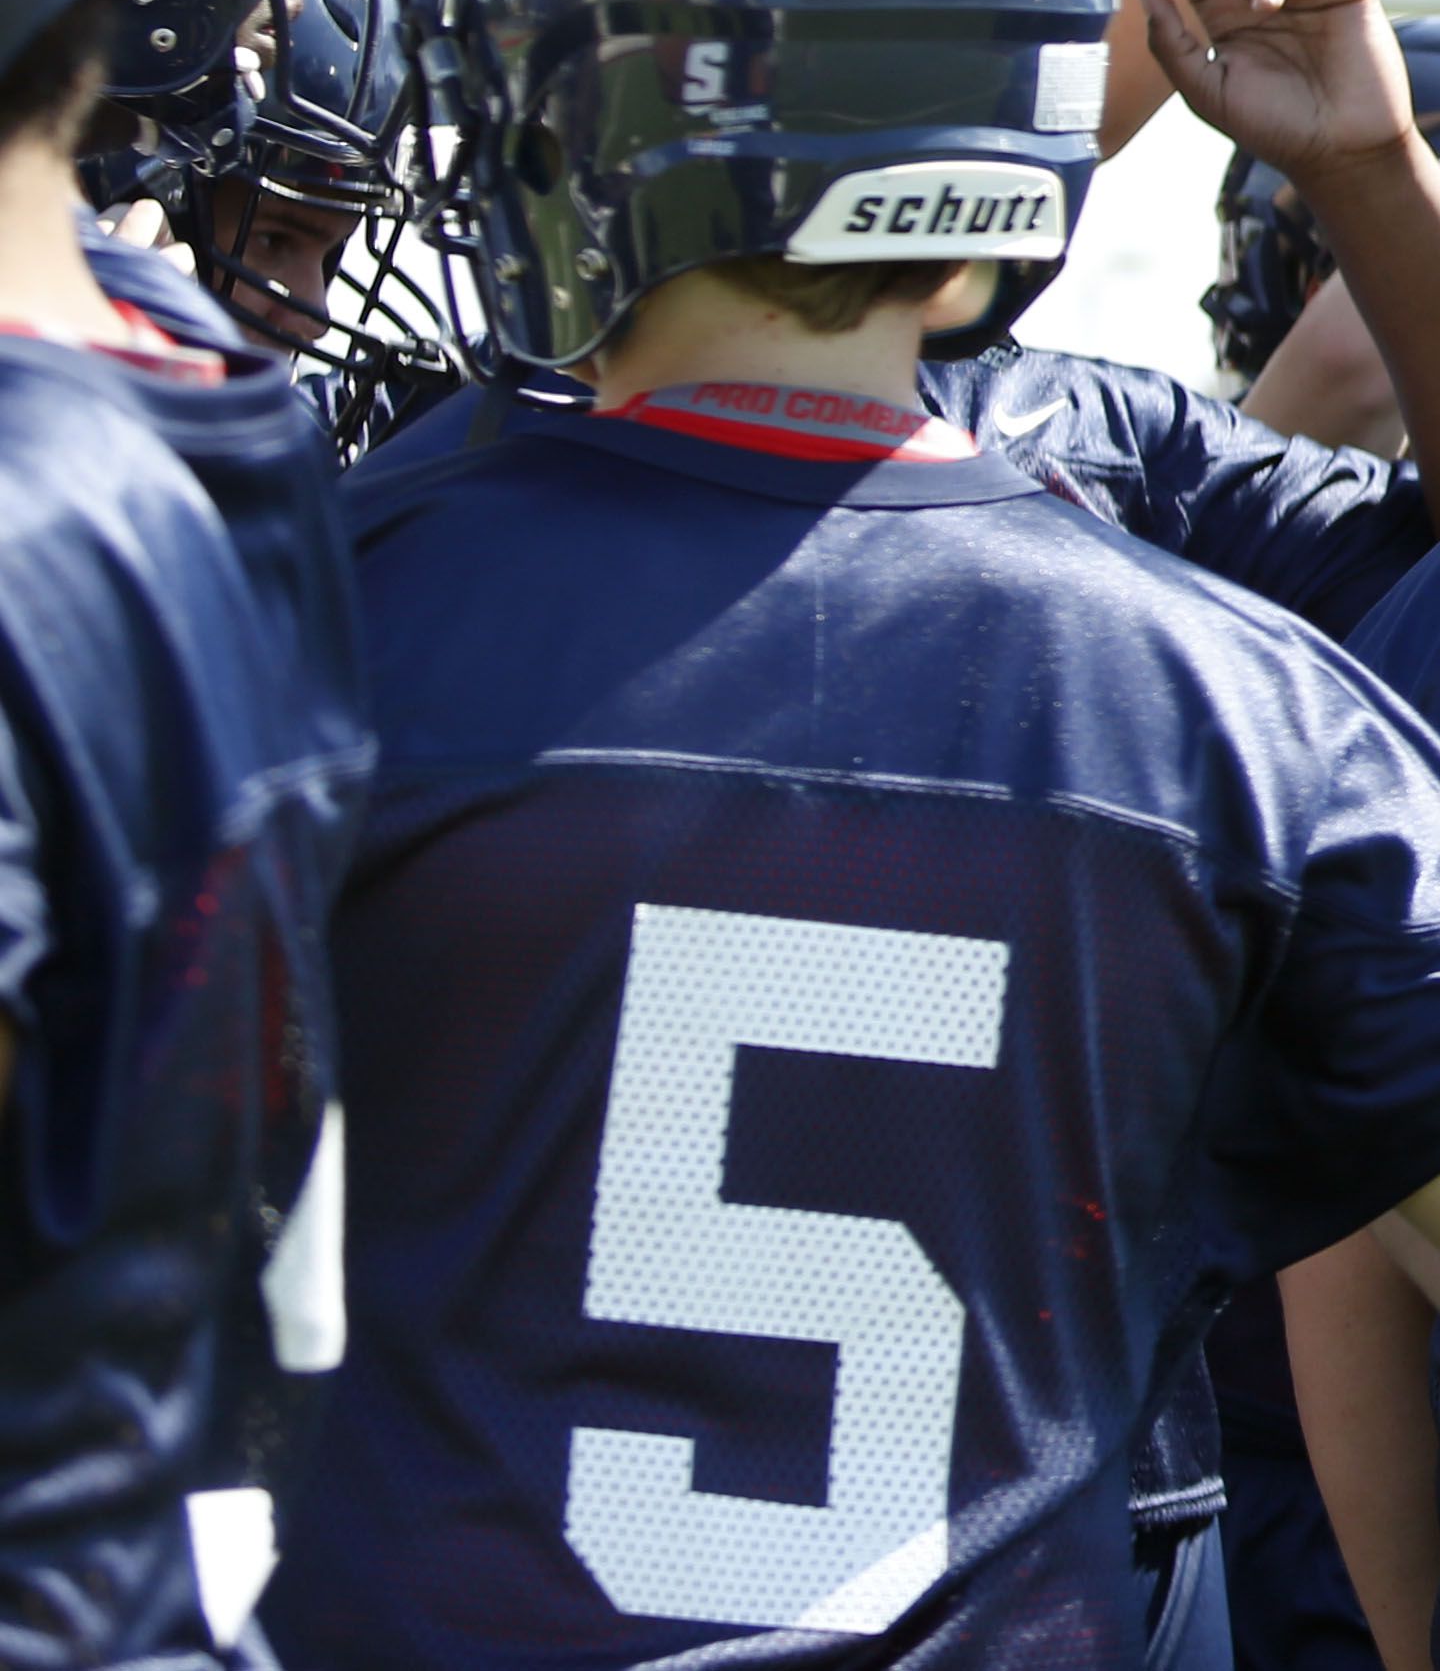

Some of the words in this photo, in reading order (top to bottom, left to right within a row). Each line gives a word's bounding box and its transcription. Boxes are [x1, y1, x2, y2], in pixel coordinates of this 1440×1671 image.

[845, 183, 1047, 233] schutt
[691, 382, 779, 415] PRO
[562, 901, 1006, 1635] 5
